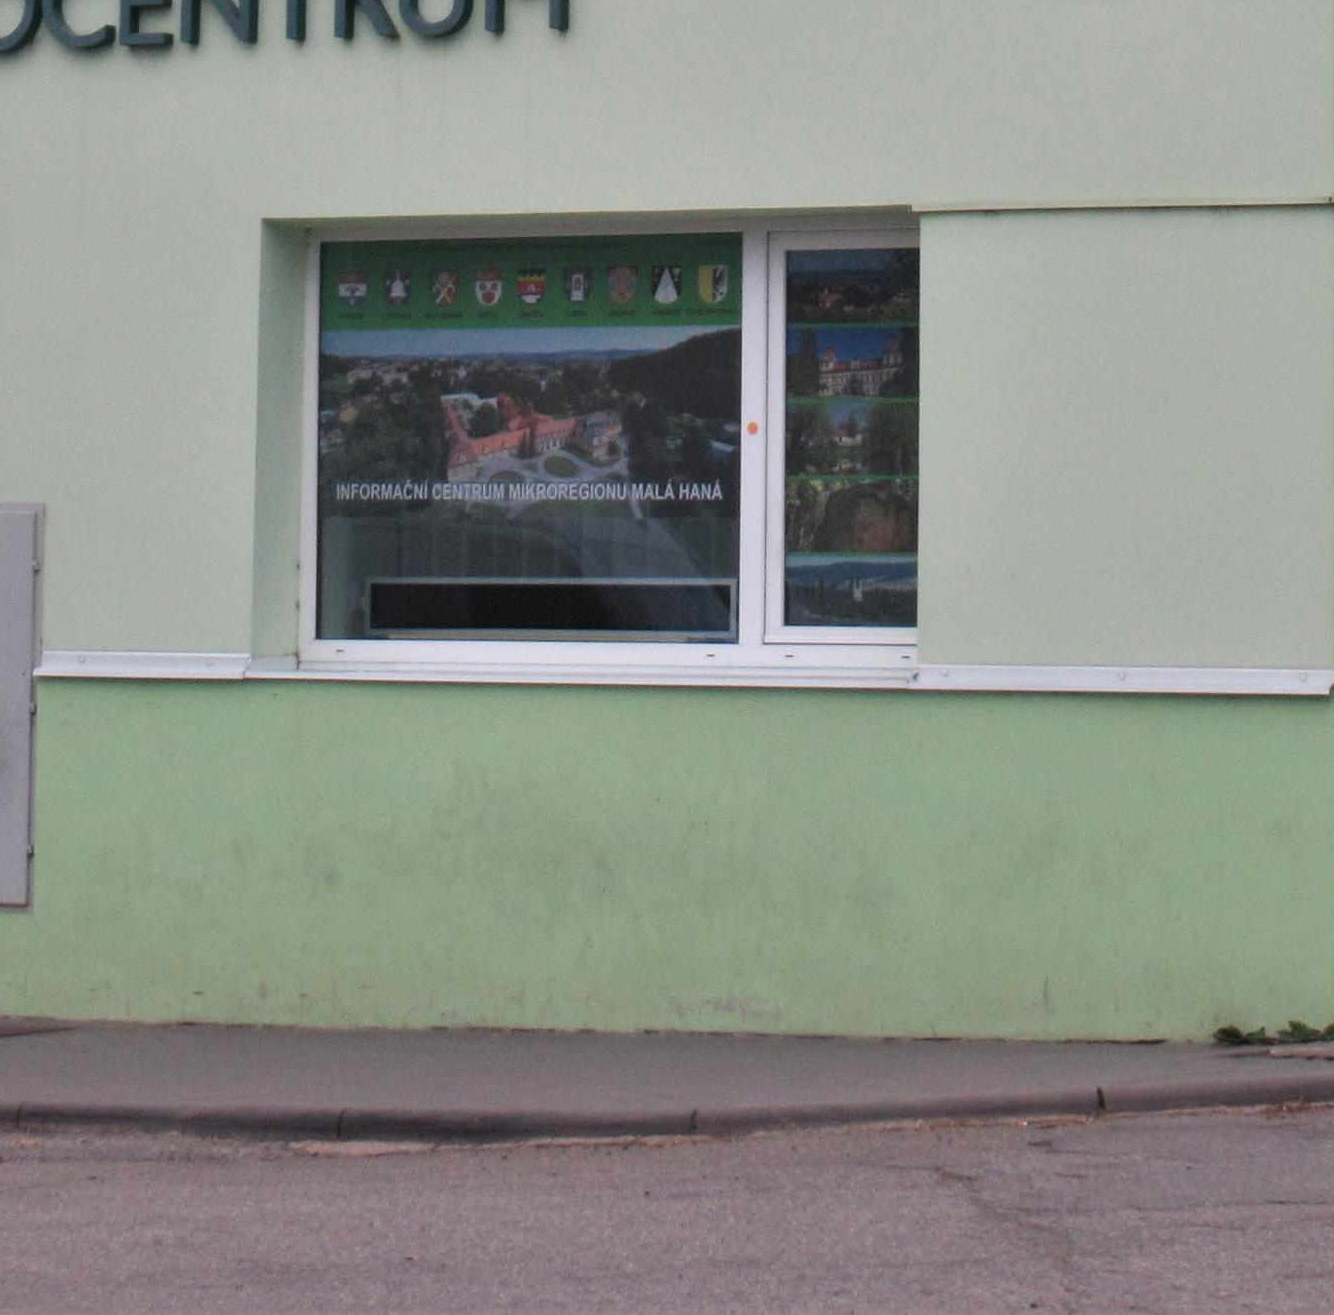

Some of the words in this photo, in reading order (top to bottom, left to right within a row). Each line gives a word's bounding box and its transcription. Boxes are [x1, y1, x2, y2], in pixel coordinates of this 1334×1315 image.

[335, 482, 429, 500] INFORMAČNÍ
[432, 483, 504, 500] CENTRUM
[508, 482, 627, 500] MIKROREGIONU
[630, 481, 675, 500] MALÁ
[678, 480, 723, 500] HANÁ
